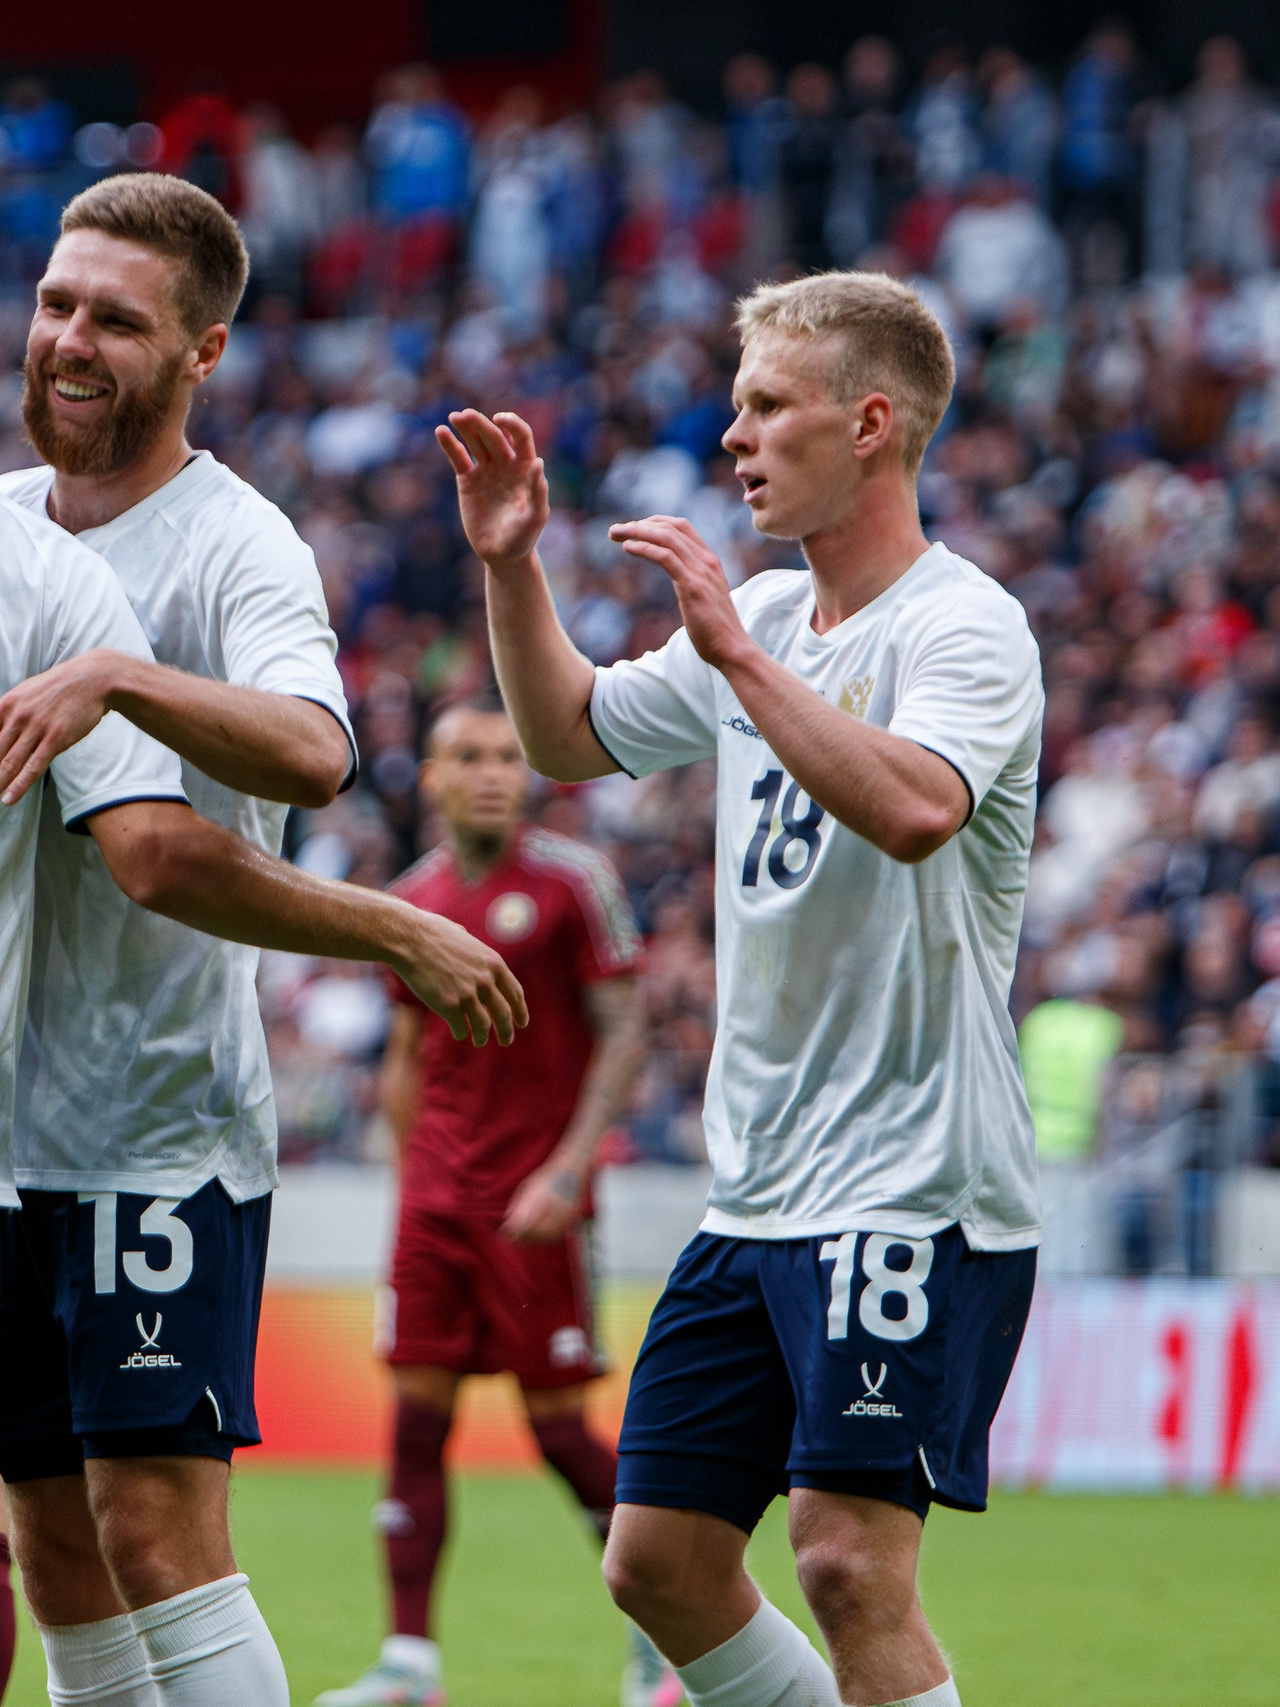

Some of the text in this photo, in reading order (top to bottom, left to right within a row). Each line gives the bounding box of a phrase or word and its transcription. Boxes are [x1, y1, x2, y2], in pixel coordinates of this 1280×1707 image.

[742, 768, 826, 890] 18
[76, 1191, 194, 1295] 13
[818, 1231, 935, 1342] 18
[119, 1352, 183, 1369] JÖGEL
[841, 1400, 904, 1418] JÖGEL
